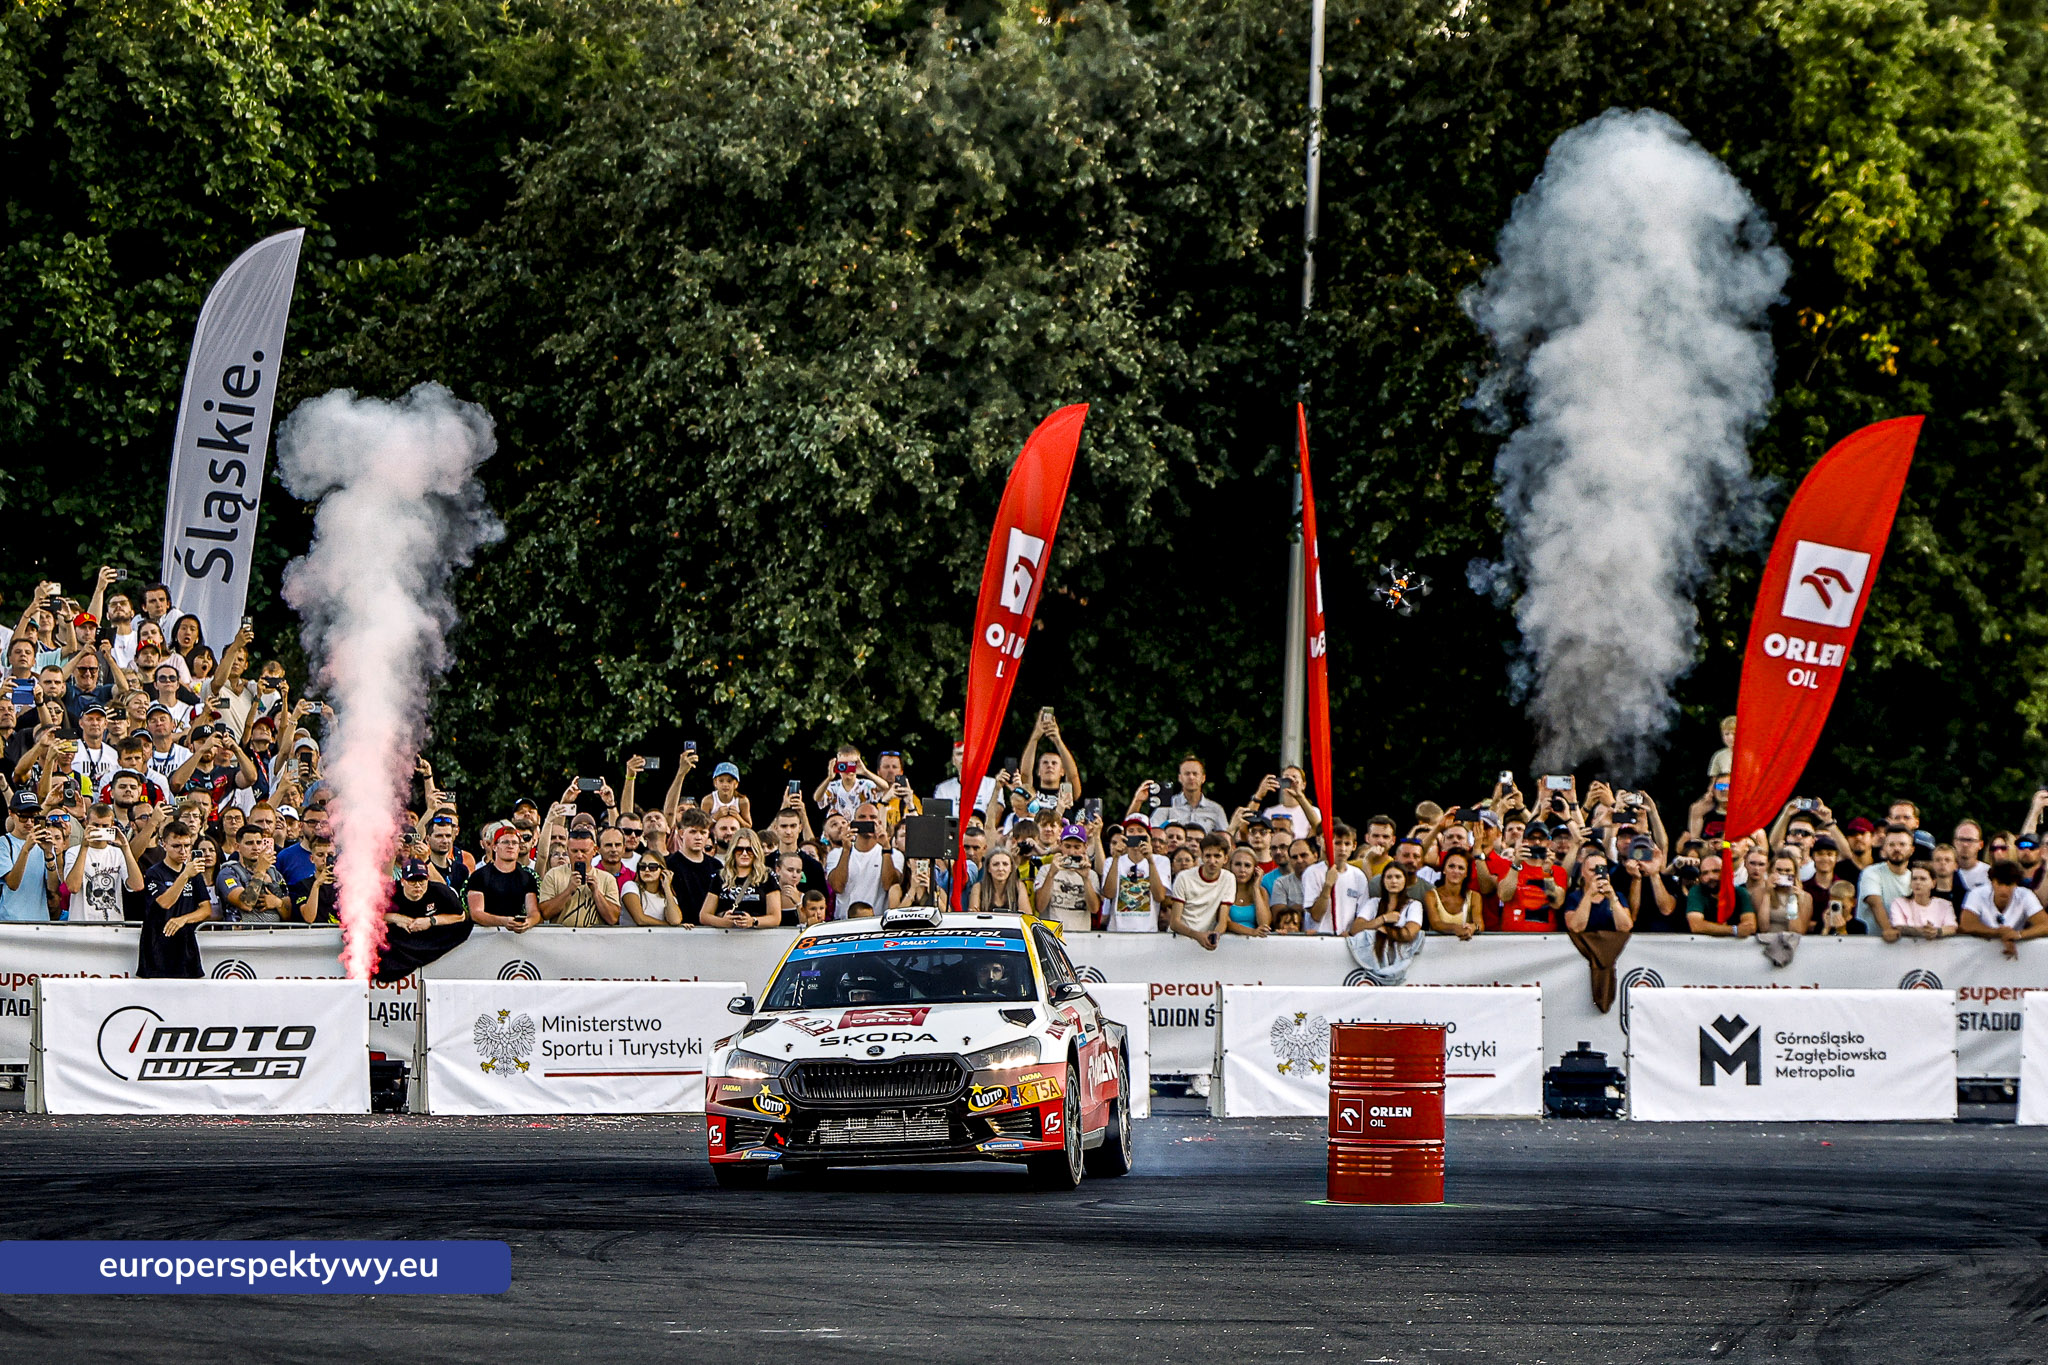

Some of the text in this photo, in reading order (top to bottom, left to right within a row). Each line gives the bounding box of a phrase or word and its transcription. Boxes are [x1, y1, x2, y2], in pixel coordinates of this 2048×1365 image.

[174, 350, 265, 584] Śląskie.
[1787, 668, 1819, 689] OIL
[542, 1015, 662, 1033] Ministerstwo
[851, 1015, 914, 1025] ORLEN
[147, 1026, 316, 1052] MOTO
[1775, 1031, 1865, 1048] Górnośląsko
[541, 1037, 703, 1060] Sportu i Turystyki
[143, 1059, 300, 1078] WIZJA
[1775, 1065, 1855, 1081] Metropolia
[760, 1095, 783, 1112] LOTTO
[975, 1088, 1003, 1107] LOTTO
[1370, 1106, 1412, 1118] ORLEN
[1370, 1119, 1387, 1128] OIL
